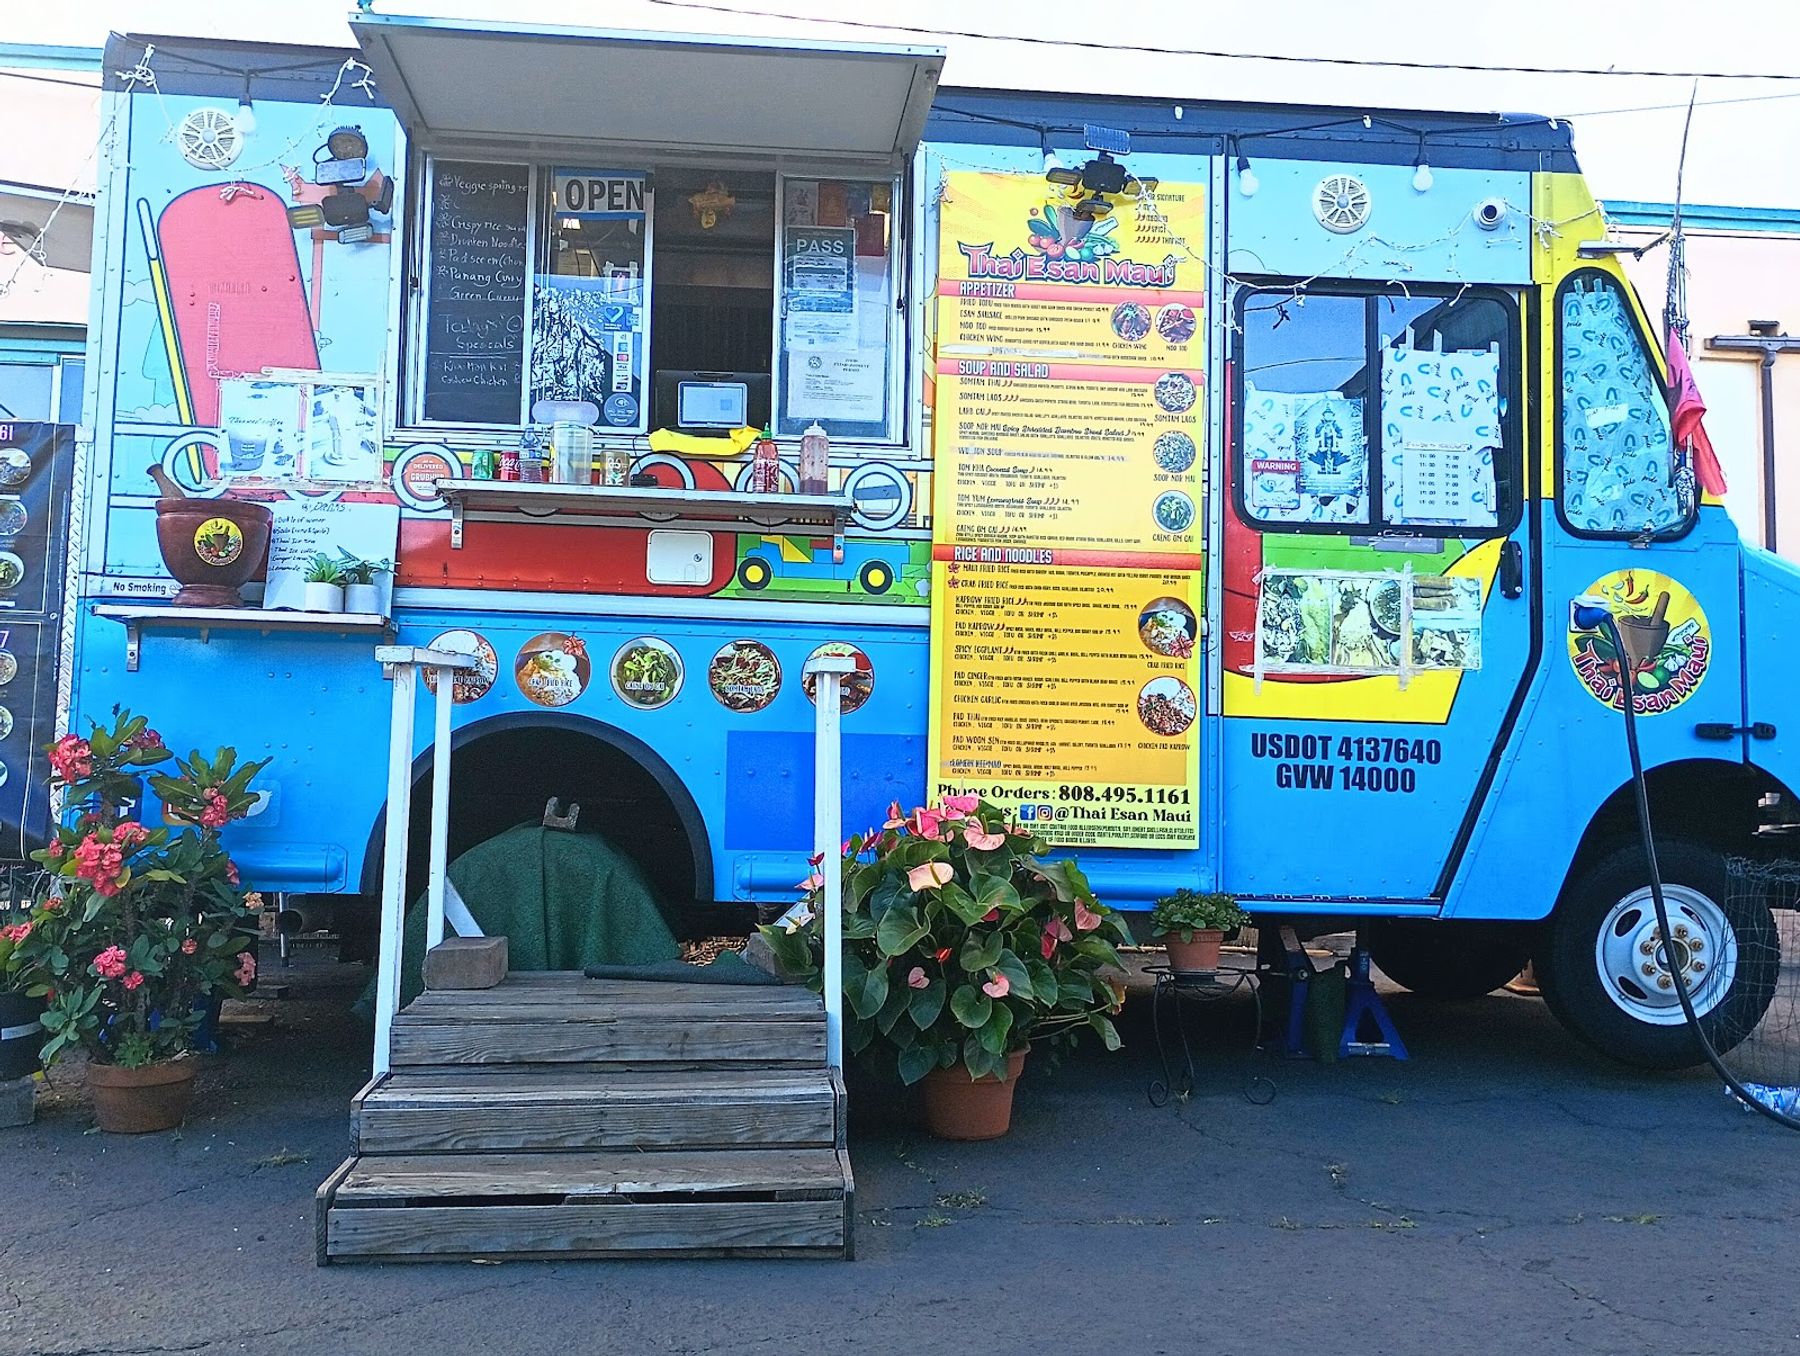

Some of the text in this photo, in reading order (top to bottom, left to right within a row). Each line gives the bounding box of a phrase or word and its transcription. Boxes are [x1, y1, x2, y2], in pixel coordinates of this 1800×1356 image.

[453, 175, 487, 195] Veggie
[488, 179, 517, 196] spring
[565, 178, 644, 211] OPEN
[451, 215, 482, 235] Crispy
[484, 221, 502, 231] rice
[796, 238, 844, 254] PASS
[957, 240, 1177, 287] Thai Esan Maui
[450, 266, 491, 288] Panang
[960, 281, 1016, 298] APPETIZER
[960, 310, 975, 318] ESAN
[960, 333, 985, 342] CHICKEN
[959, 360, 1049, 378] SOUP AND SALAD
[987, 394, 1002, 402] LAOS
[1002, 424, 1020, 433] Spicy
[1022, 425, 1052, 433] Shredded
[1054, 426, 1082, 434] Bamboo
[1104, 428, 1124, 436] Salad
[1622, 451, 1637, 459] pride
[985, 465, 1010, 473] Coconut
[1012, 466, 1028, 474] Soup
[1256, 461, 1297, 471] WARNING
[1026, 497, 1043, 505] Soup
[1566, 508, 1582, 516] pride
[954, 546, 1053, 564] RICE AND NOODLES
[979, 564, 996, 573] FRIED
[113, 581, 167, 595] No Smoking
[954, 645, 972, 653] SPICY
[1572, 639, 1617, 700] Thai
[1669, 634, 1710, 698] Maui
[954, 694, 978, 703] CHICKEN
[1251, 732, 1442, 765] USDOT 4137640
[1276, 763, 1416, 793] GVW 14000
[991, 785, 1056, 799] Orders:
[1058, 784, 1191, 805] 808.495.1161
[1055, 805, 1191, 822] @Thai Esan Maui
